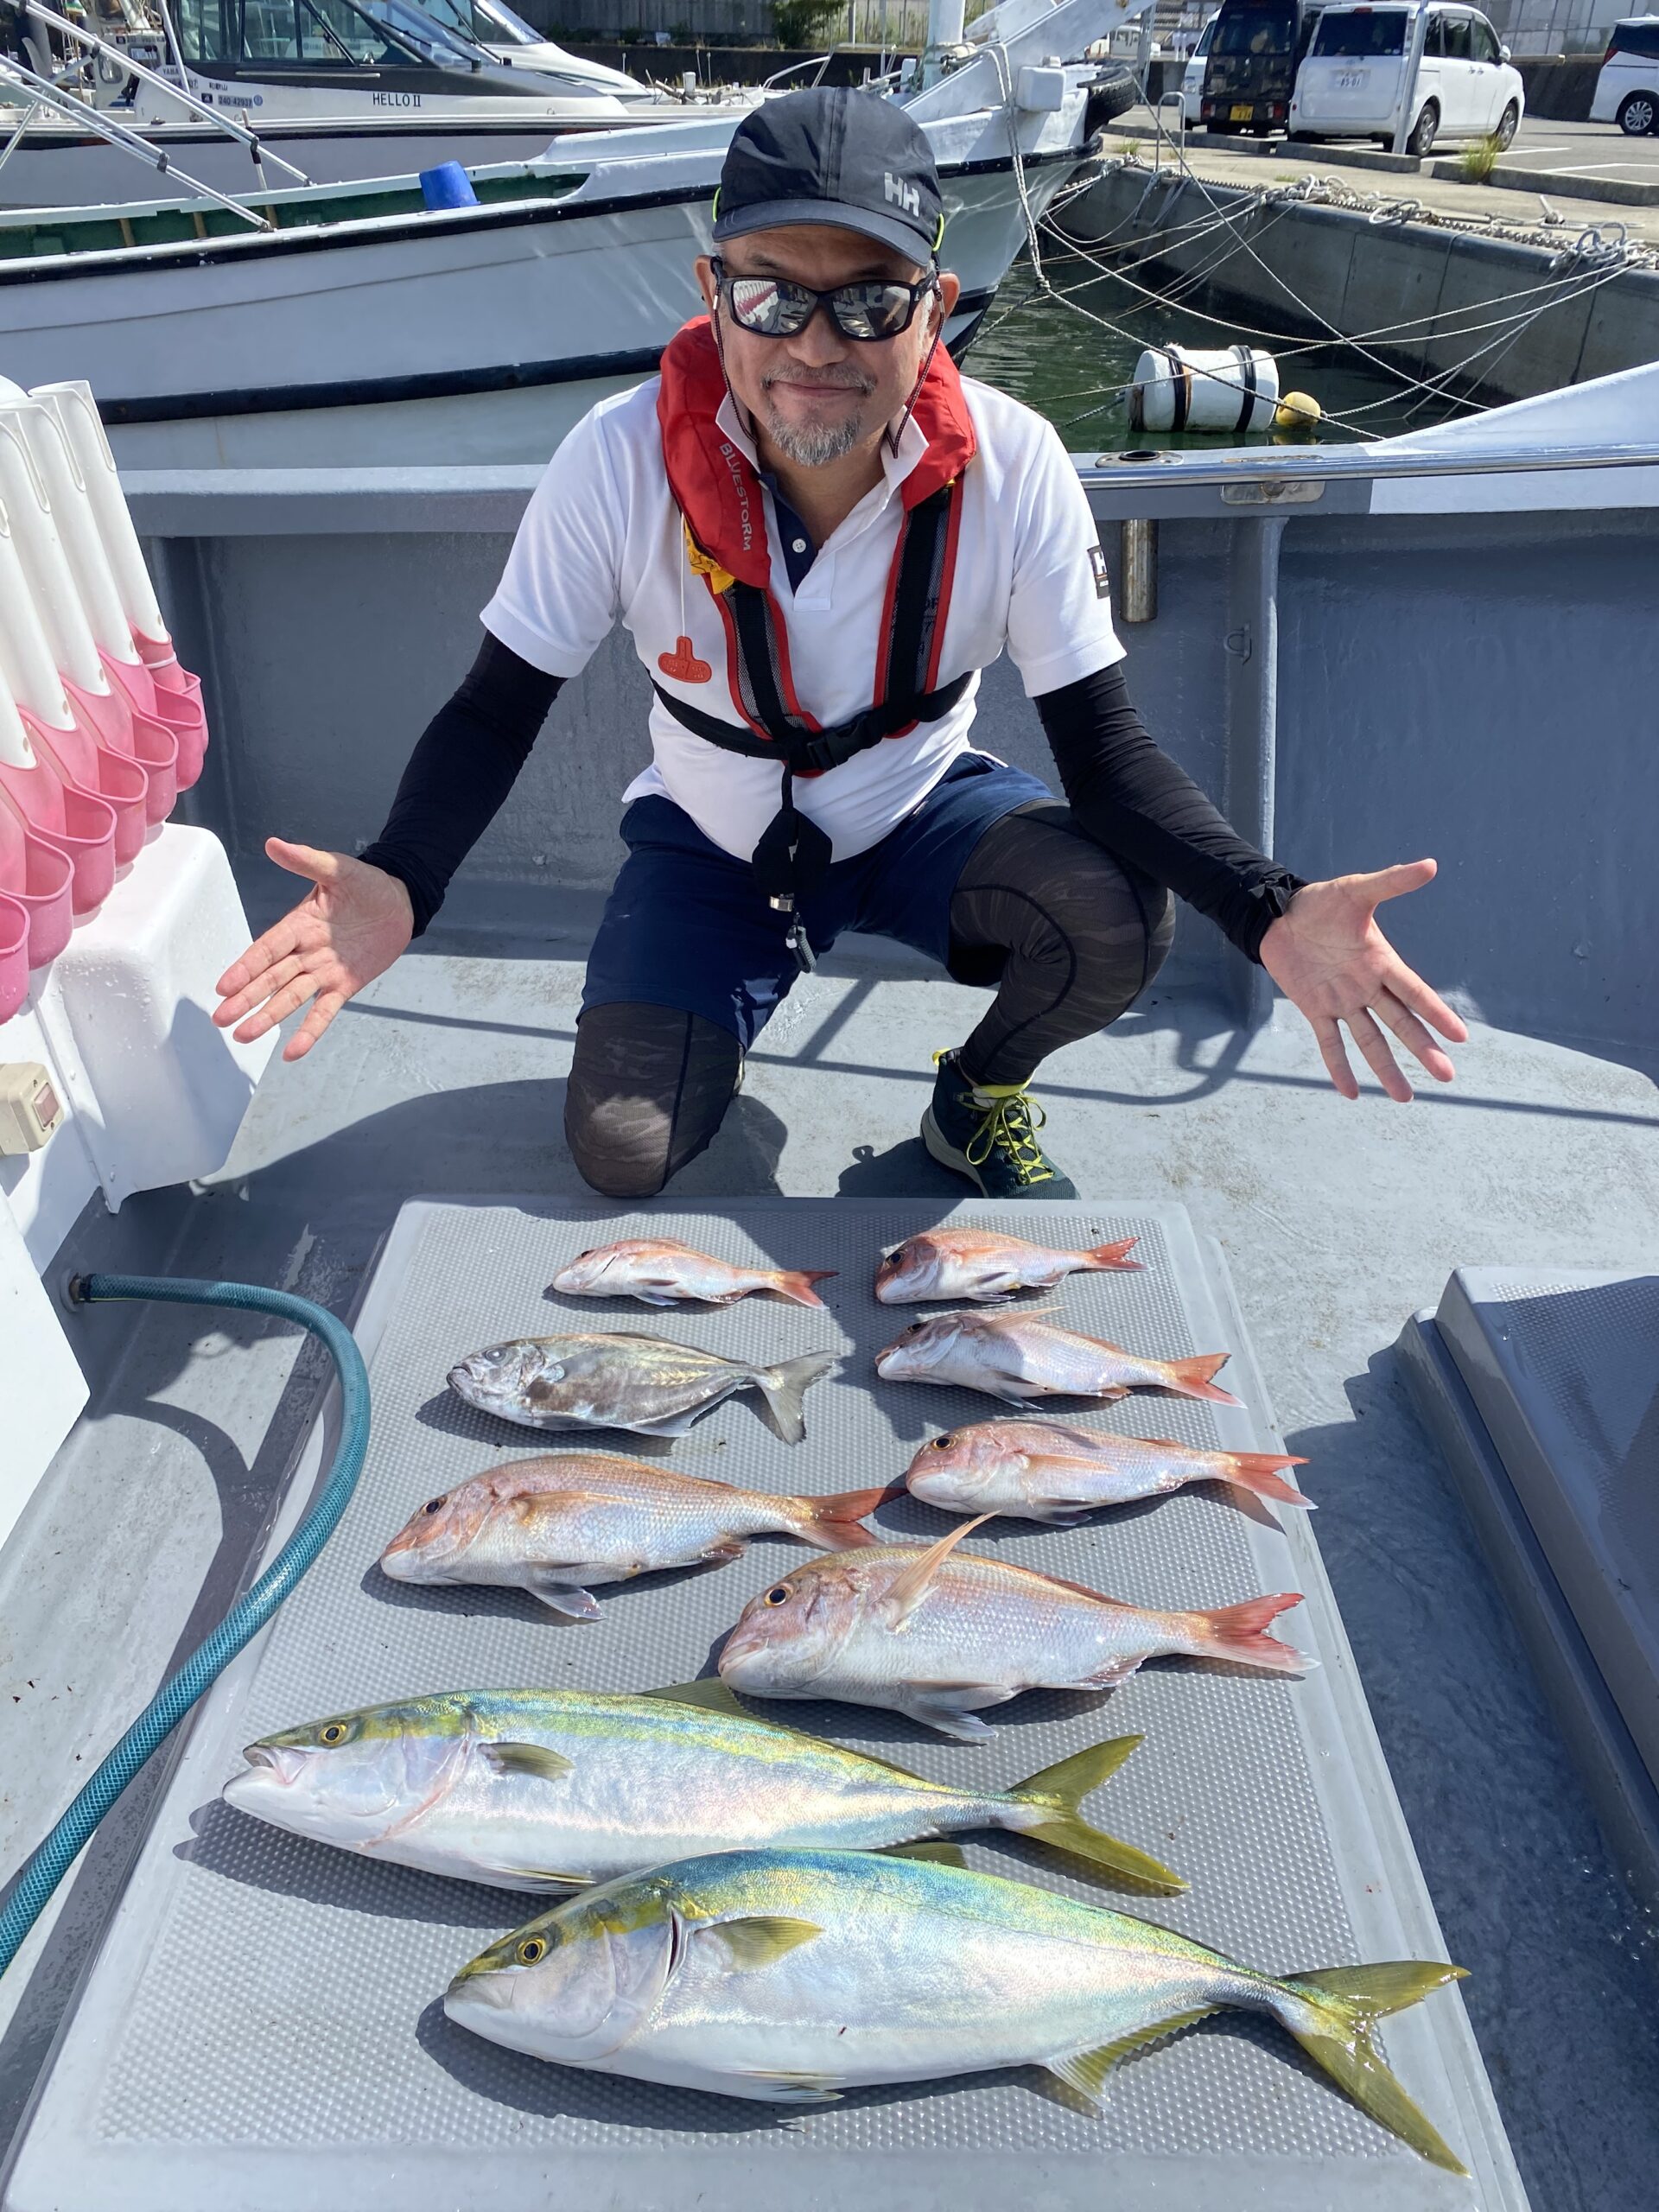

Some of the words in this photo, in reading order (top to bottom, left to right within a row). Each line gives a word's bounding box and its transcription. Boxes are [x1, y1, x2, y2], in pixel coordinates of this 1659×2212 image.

[372, 92, 410, 107] HELLO
[884, 172, 920, 218] HH
[719, 442, 753, 551] BLUESTORM
